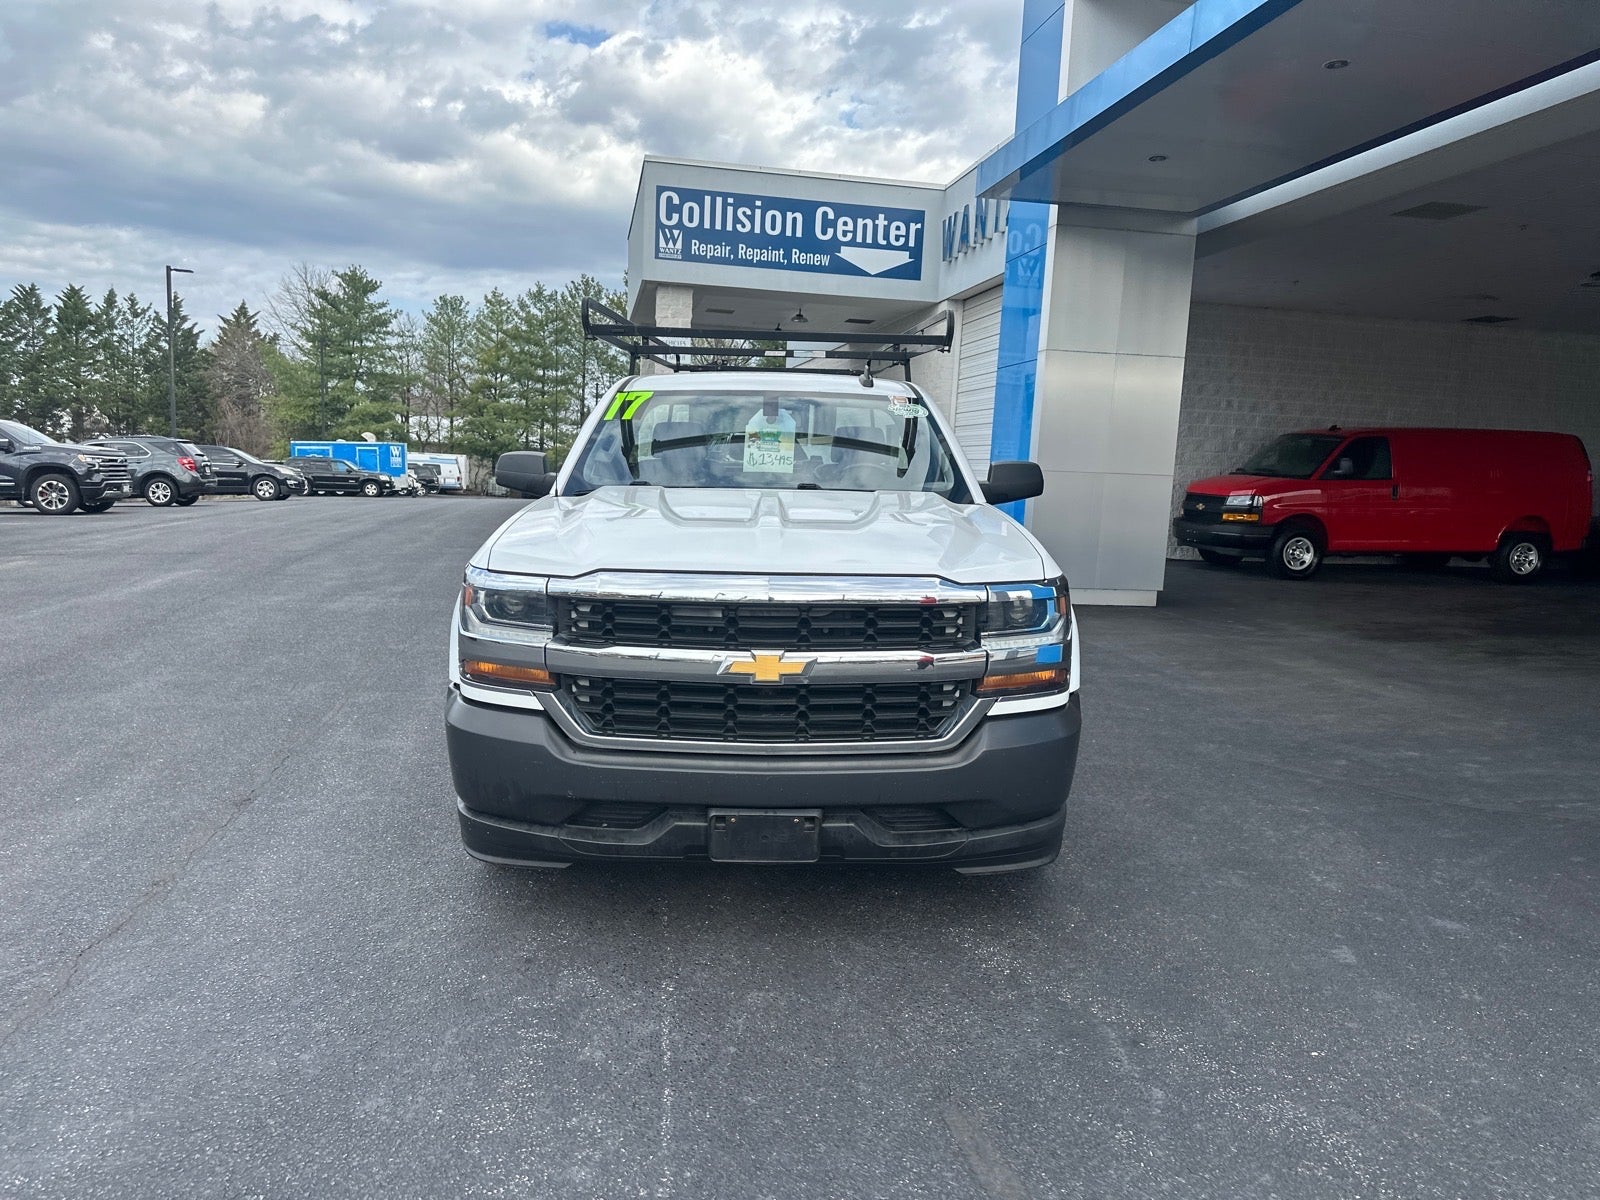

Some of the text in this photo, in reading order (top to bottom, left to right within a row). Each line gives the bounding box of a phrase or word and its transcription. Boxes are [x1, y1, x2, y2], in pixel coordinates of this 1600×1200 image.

[659, 190, 922, 248] Collision Center
[942, 198, 1010, 262] WANT
[659, 247, 682, 255] WANTZ
[691, 239, 831, 267] Repair, Repaint, Renew
[603, 391, 655, 421] 17
